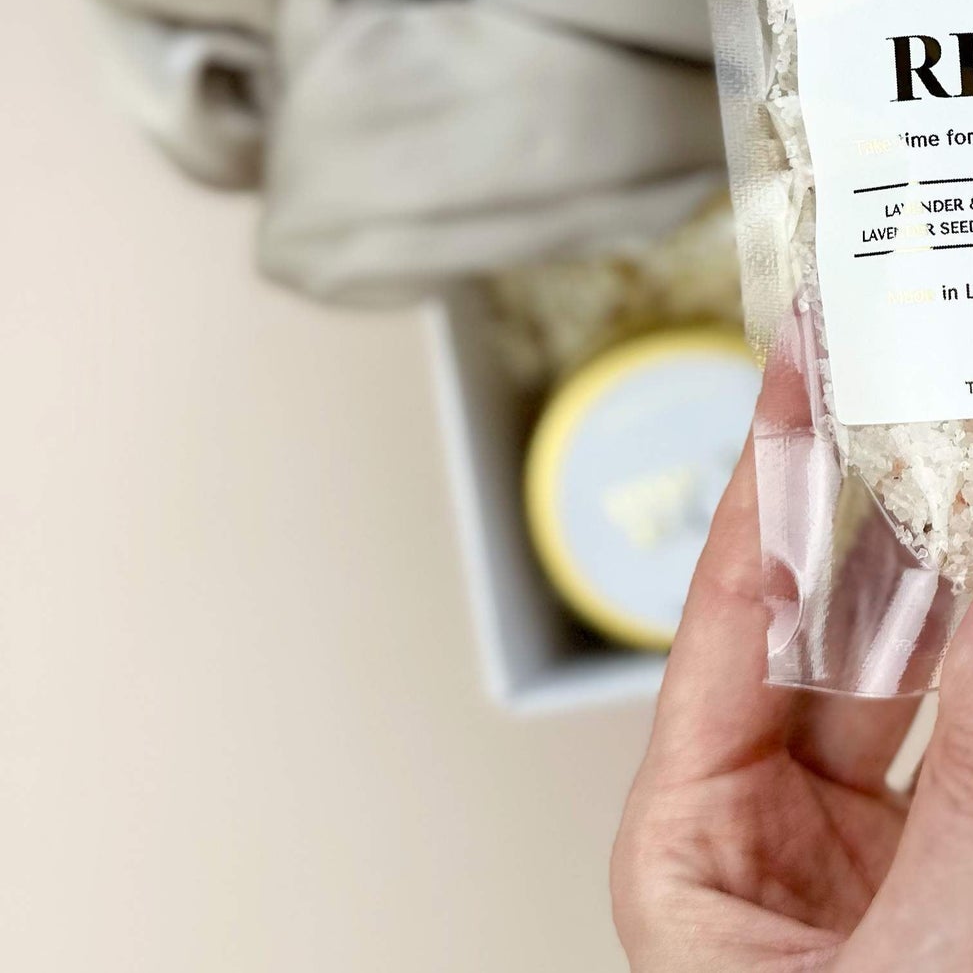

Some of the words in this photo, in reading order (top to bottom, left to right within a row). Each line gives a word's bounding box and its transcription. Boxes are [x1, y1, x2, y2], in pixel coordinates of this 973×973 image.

[899, 132, 940, 148] ime
[885, 197, 964, 218] LANDER
[862, 222, 936, 243] LAVER
[942, 285, 959, 301] in
